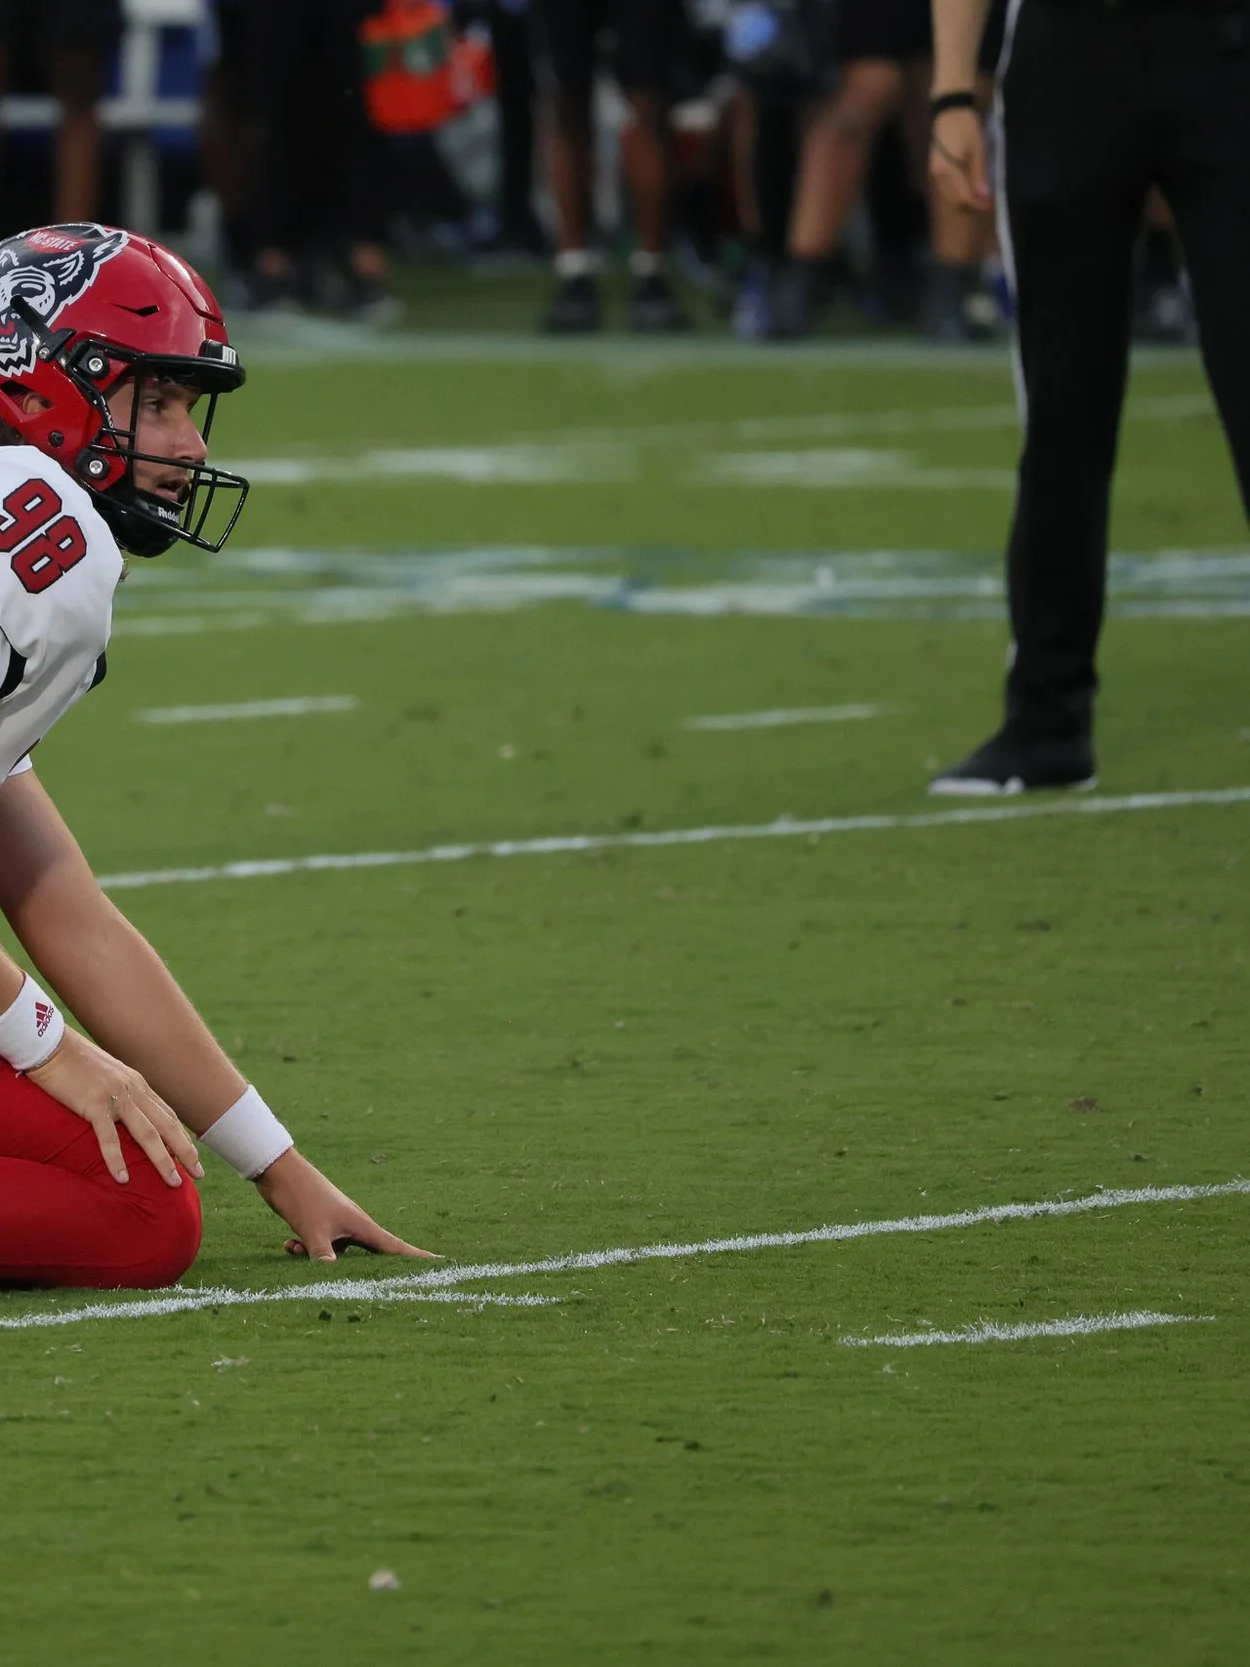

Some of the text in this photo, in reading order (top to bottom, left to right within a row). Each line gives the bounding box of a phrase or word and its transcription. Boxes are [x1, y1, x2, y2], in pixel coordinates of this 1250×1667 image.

[42, 236, 79, 251] STATE
[157, 506, 180, 524] Ridd
[37, 1004, 54, 1037] adidas
